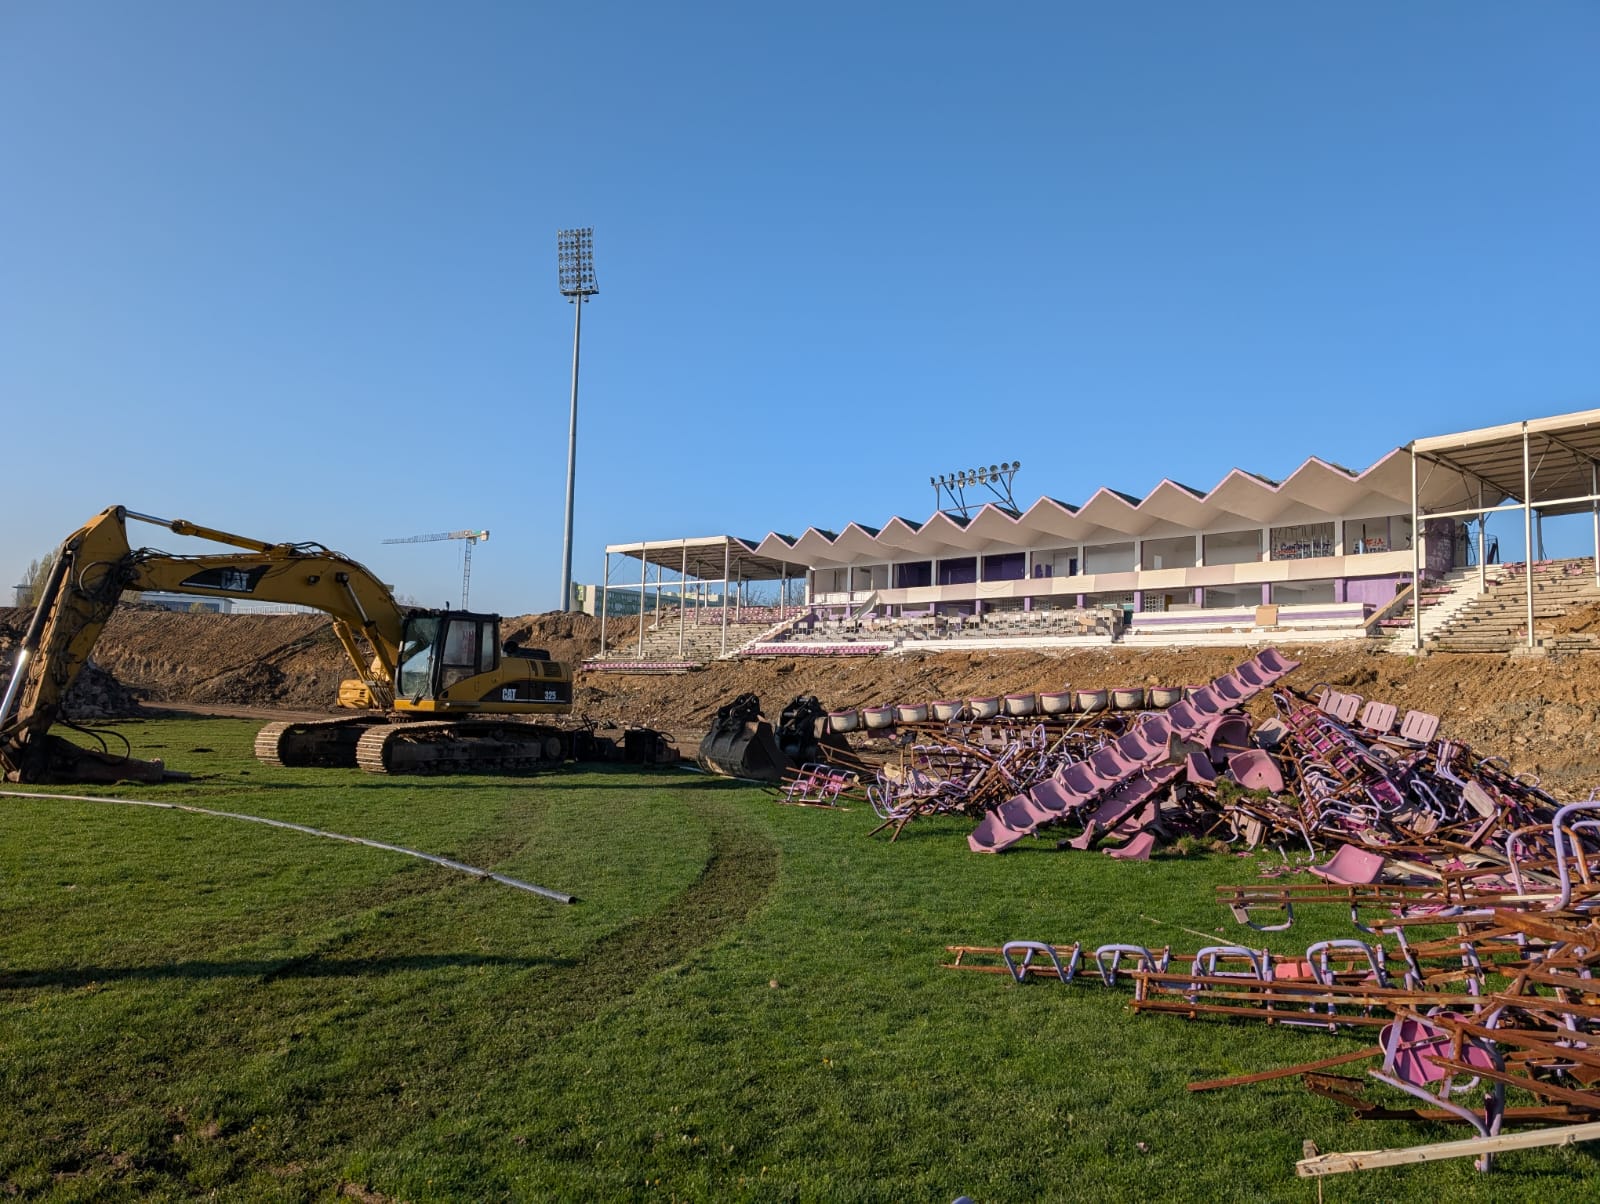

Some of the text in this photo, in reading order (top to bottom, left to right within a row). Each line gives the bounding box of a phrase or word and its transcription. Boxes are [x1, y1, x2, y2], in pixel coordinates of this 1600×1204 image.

[221, 571, 249, 590] CAT
[502, 688, 517, 701] CAT
[544, 691, 557, 700] 325
